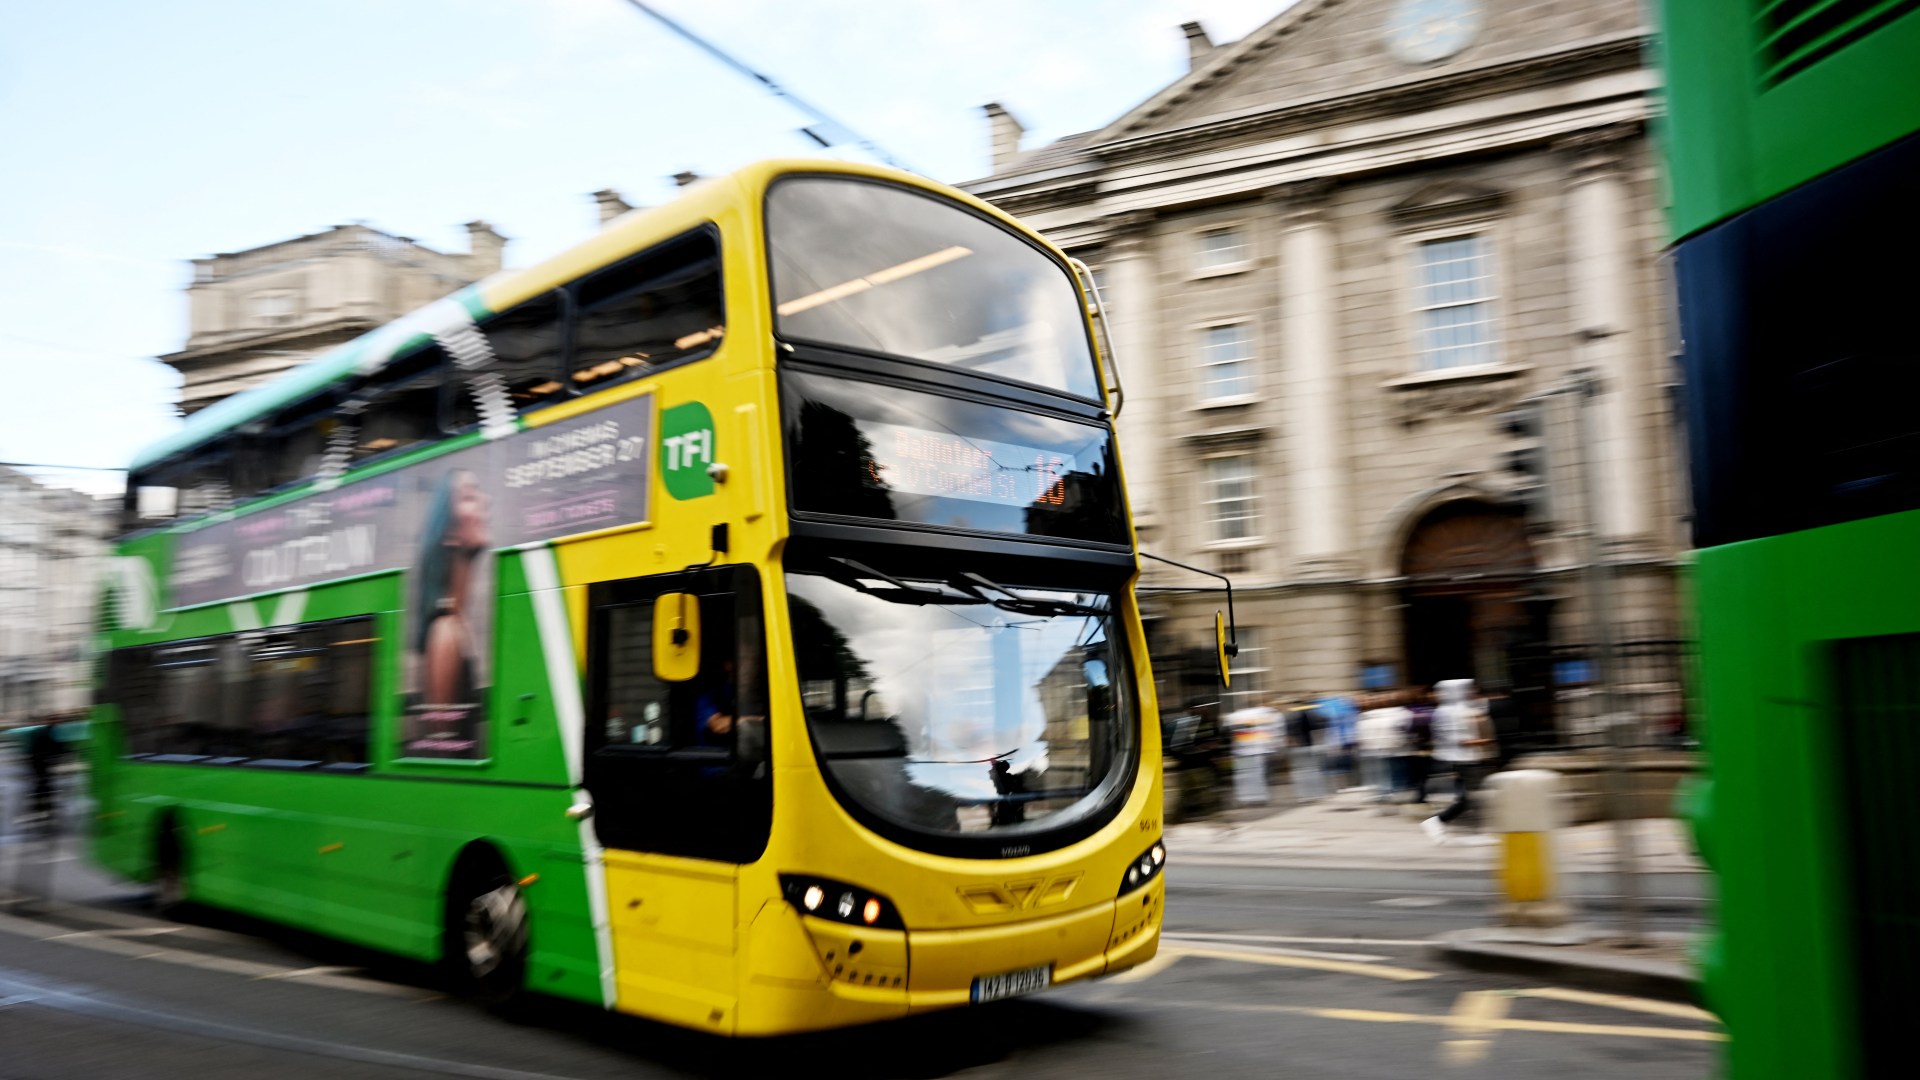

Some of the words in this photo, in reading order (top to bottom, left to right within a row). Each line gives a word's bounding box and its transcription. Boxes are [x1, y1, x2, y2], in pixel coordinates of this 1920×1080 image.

[504, 443, 616, 488] SEPTEMBER
[617, 435, 646, 462] 27
[664, 429, 712, 471] TFI
[1034, 454, 1066, 505] 16
[1001, 845, 1031, 858] VOLVO
